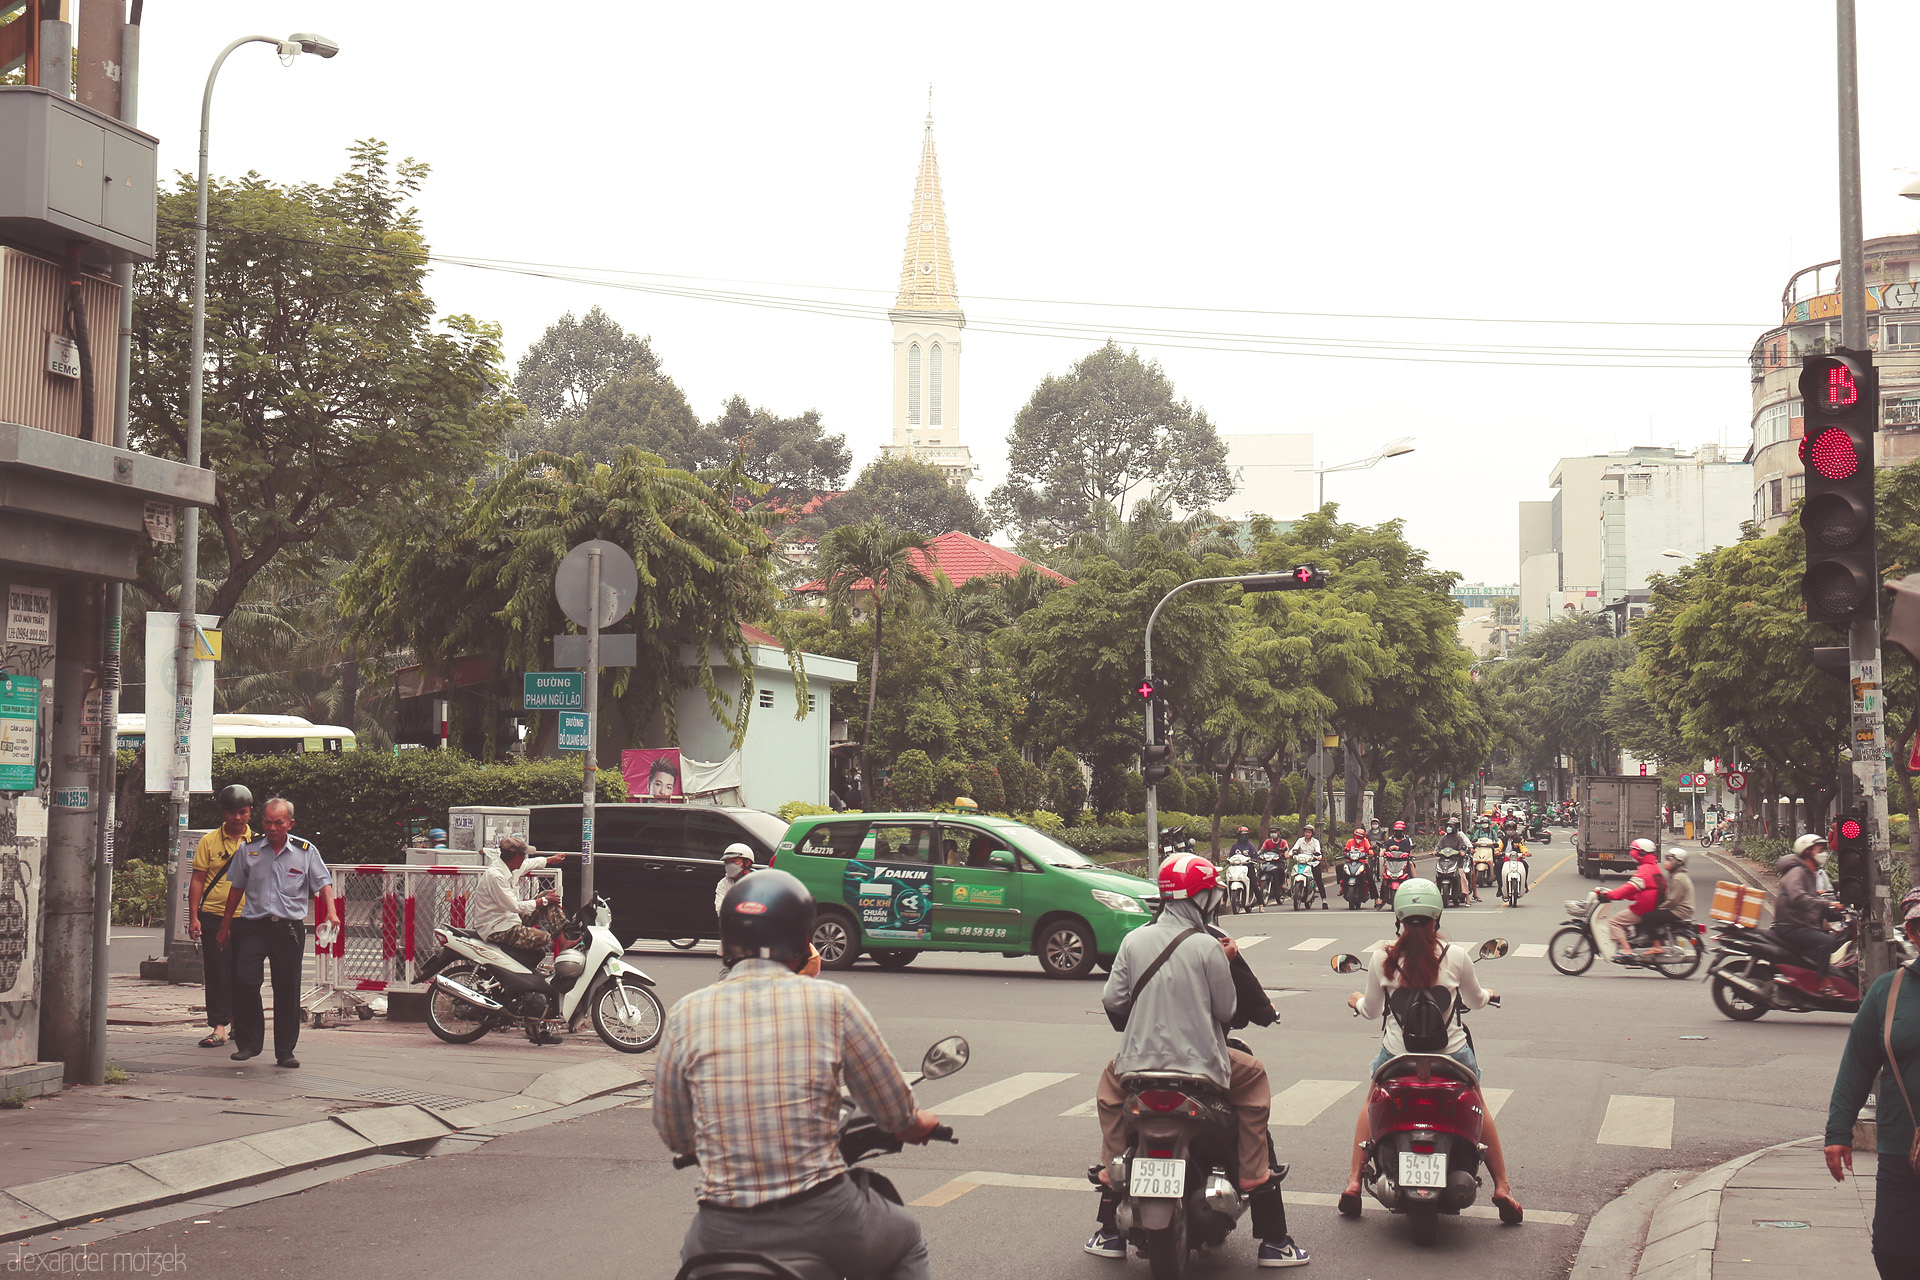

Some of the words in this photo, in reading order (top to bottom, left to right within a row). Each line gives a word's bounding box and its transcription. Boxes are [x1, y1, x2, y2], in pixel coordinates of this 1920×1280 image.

[52, 361, 78, 376] EEMC
[1453, 587, 1482, 595] HOTEL
[1483, 587, 1493, 595] 82
[1494, 587, 1515, 595] T.T.T
[537, 676, 571, 687] ĐƯỜNG
[526, 693, 547, 707] PHẠM
[548, 691, 564, 705] NGŨ
[566, 691, 580, 705] LÃO
[565, 717, 584, 727] ĐƯỜNG
[884, 870, 928, 880] DAIKIN
[859, 899, 876, 908] LỌC
[876, 898, 892, 908] KHÍ
[863, 908, 888, 916] CHUẨN
[960, 927, 972, 936] 38
[972, 927, 984, 937] 38
[983, 928, 995, 937] 38
[995, 928, 1007, 938] 38
[1406, 1155, 1440, 1170] 54-T4
[1140, 1161, 1176, 1177] 59-U1
[1405, 1171, 1440, 1185] 2997
[1133, 1178, 1181, 1195] 770.83
